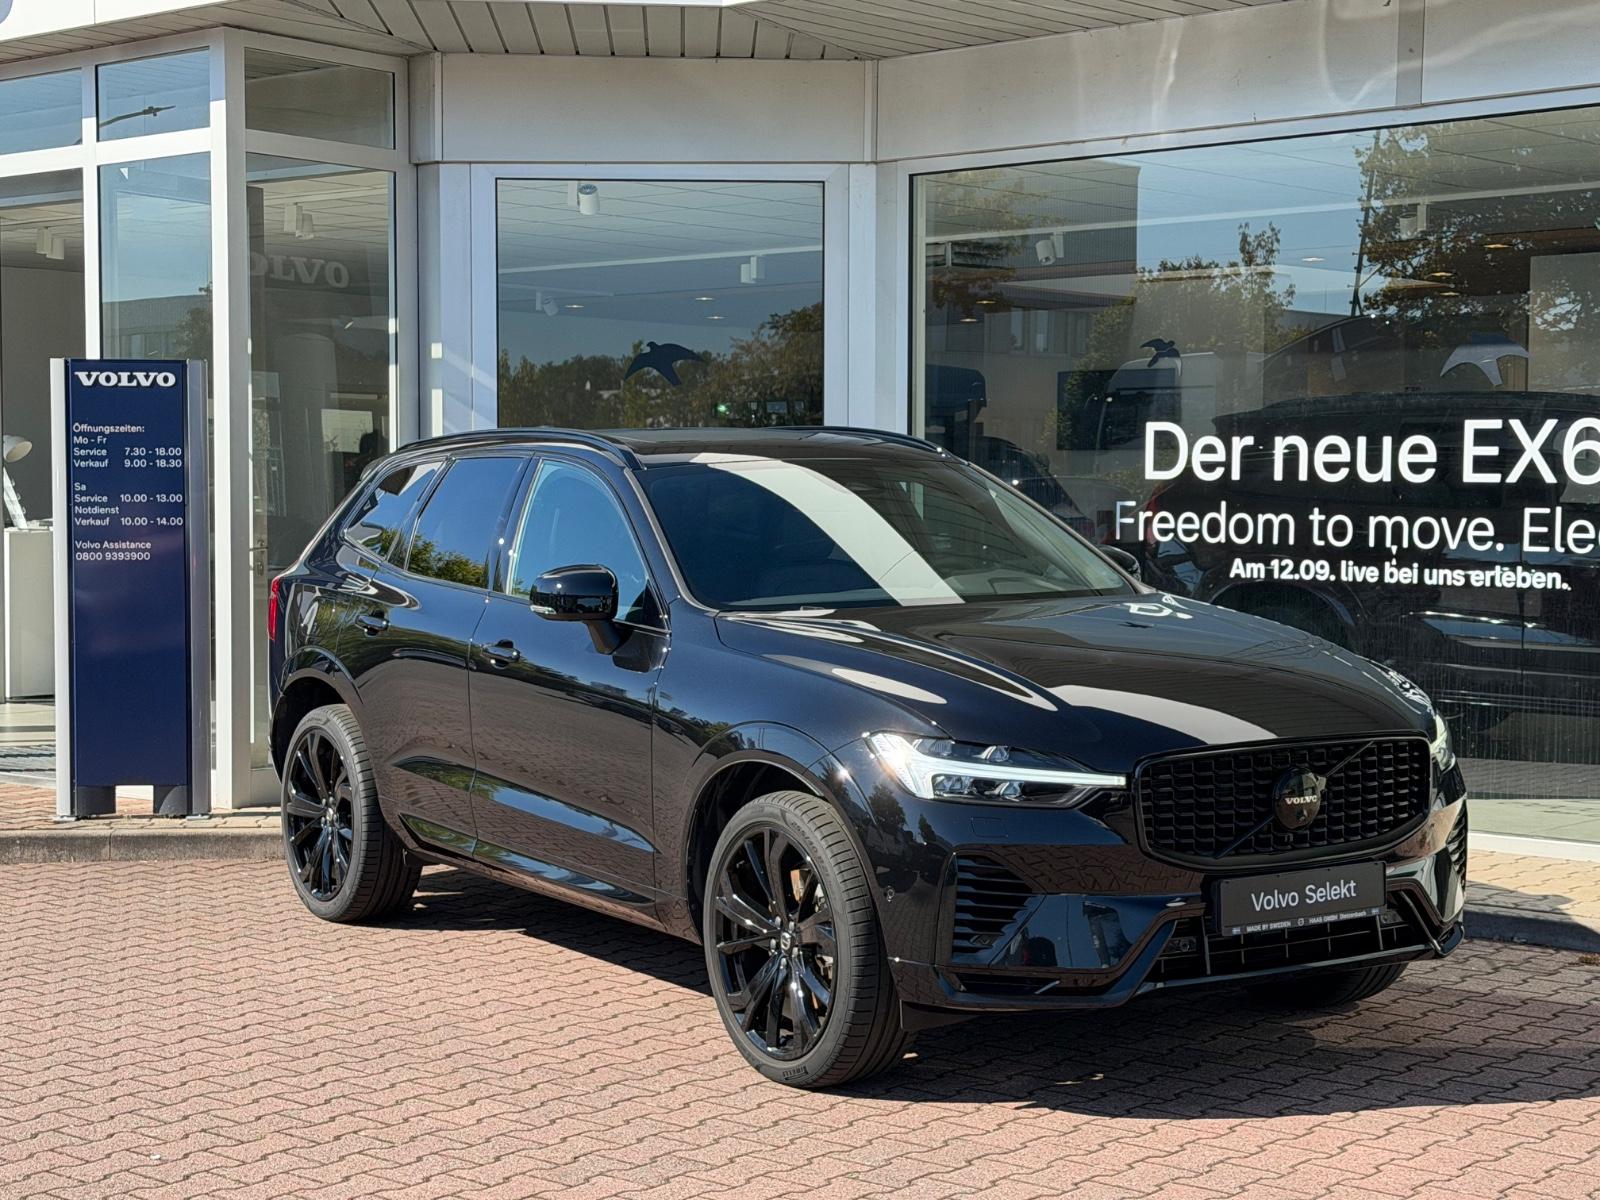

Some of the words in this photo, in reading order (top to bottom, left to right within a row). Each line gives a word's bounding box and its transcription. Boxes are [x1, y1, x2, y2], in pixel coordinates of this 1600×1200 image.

[250, 251, 349, 288] OLVO
[74, 371, 176, 387] VOLVO
[73, 422, 145, 434] Öffnungszeiten:
[73, 435, 89, 445] Mo
[97, 435, 107, 444] Fr
[73, 447, 107, 456] Service
[124, 447, 147, 456] 7.30
[154, 447, 182, 456] 18.00
[1144, 421, 1254, 481] Der
[1273, 435, 1438, 483] neue
[73, 459, 109, 468] Verkauf
[124, 459, 147, 468] 9.00
[155, 459, 183, 468] 18.30
[74, 482, 87, 491] Sa
[74, 494, 108, 503] Service
[119, 494, 148, 503] 10.00
[155, 494, 183, 503] 13.00
[74, 505, 120, 515] Notdienst
[74, 517, 110, 527] Verkauf
[120, 517, 148, 526] 10.00
[156, 517, 184, 526] 14.00
[1115, 500, 1295, 546] Freedom
[1308, 507, 1354, 548] to
[1368, 515, 1505, 552] move.
[1522, 506, 1600, 554] Ele
[74, 540, 101, 549] Volvo
[102, 540, 152, 549] Assistance
[75, 552, 103, 561] 0800
[104, 551, 151, 561] 9393900
[1229, 557, 1266, 579] Am
[1270, 558, 1336, 581] 12.09.
[1340, 560, 1379, 583] live
[1384, 561, 1419, 585] bei
[1423, 568, 1466, 587] uns
[1469, 565, 1571, 591] erleben.
[1251, 889, 1299, 912] Volvo
[1305, 879, 1357, 904] Selekt
